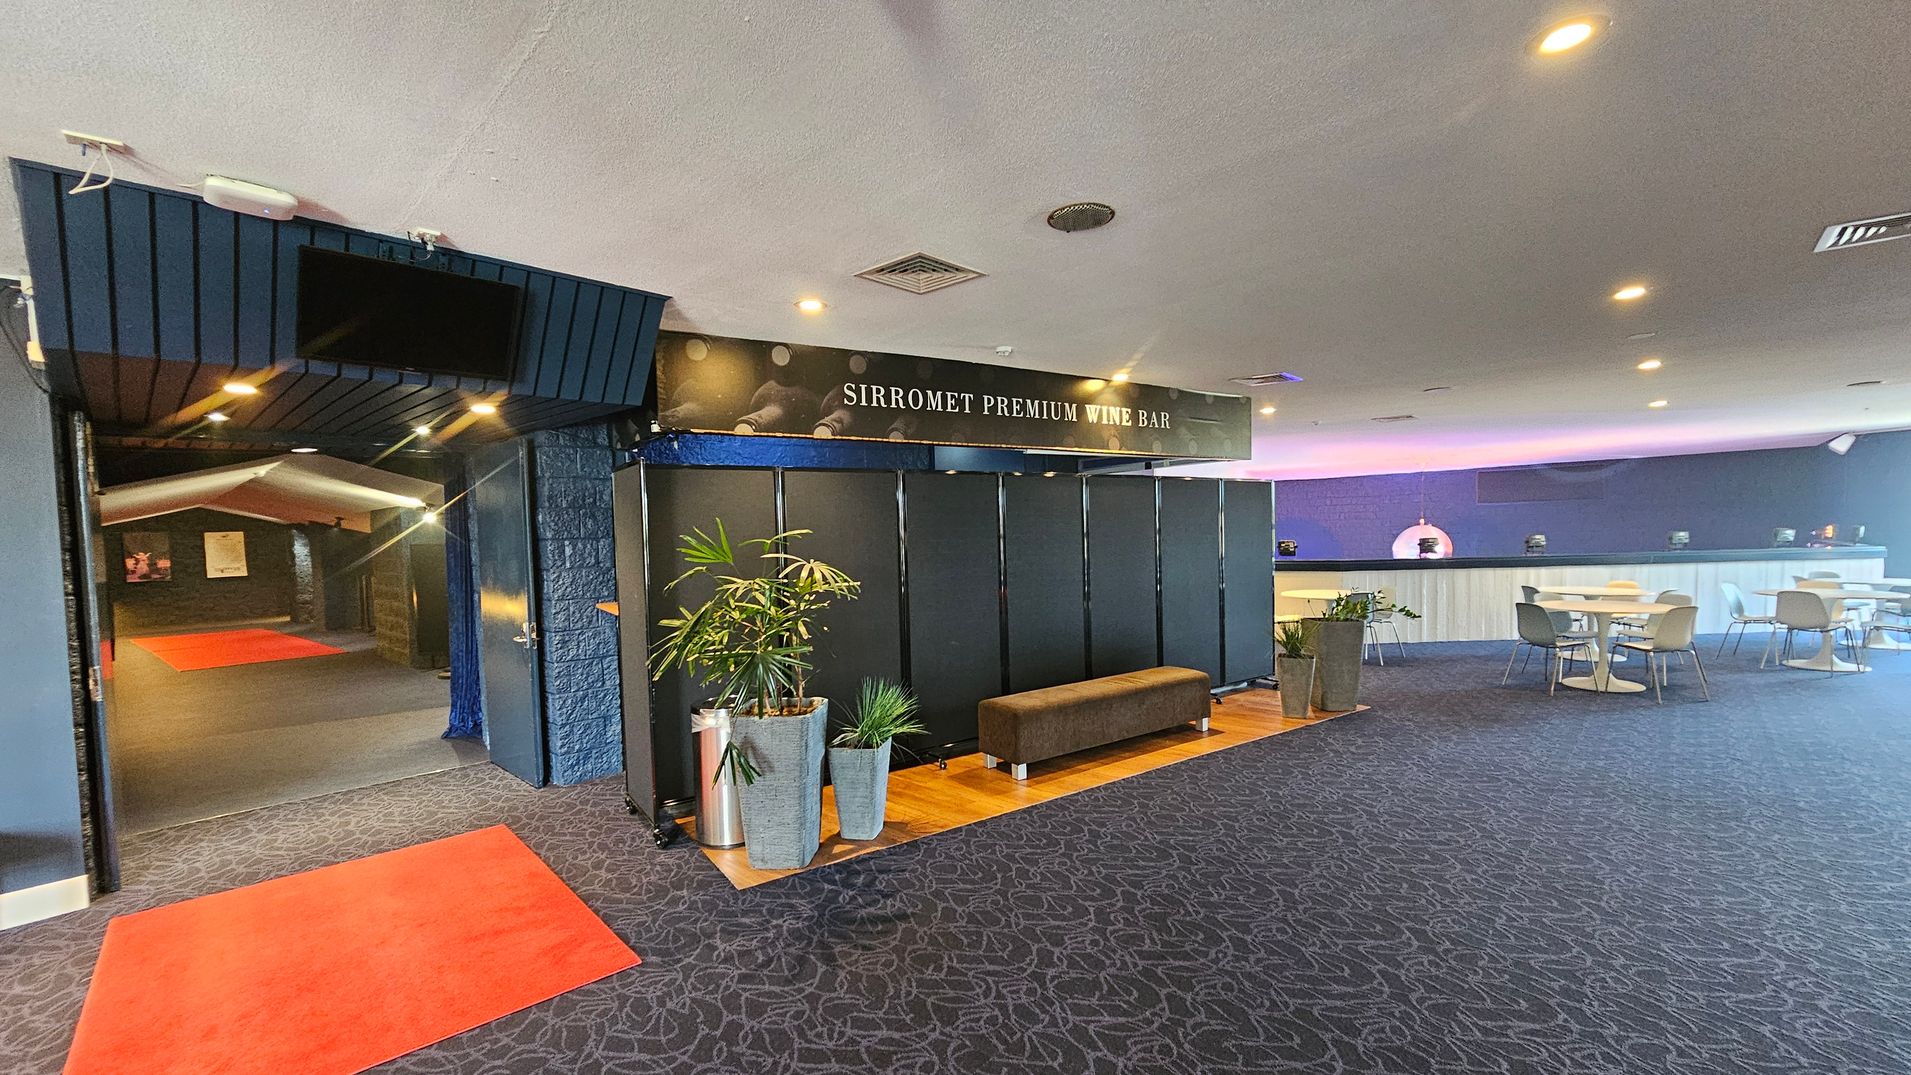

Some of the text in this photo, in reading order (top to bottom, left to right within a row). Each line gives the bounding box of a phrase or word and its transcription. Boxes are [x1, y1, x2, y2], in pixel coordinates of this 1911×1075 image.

[843, 382, 1171, 430] SIRROMET PREMIUM WINE BAR
